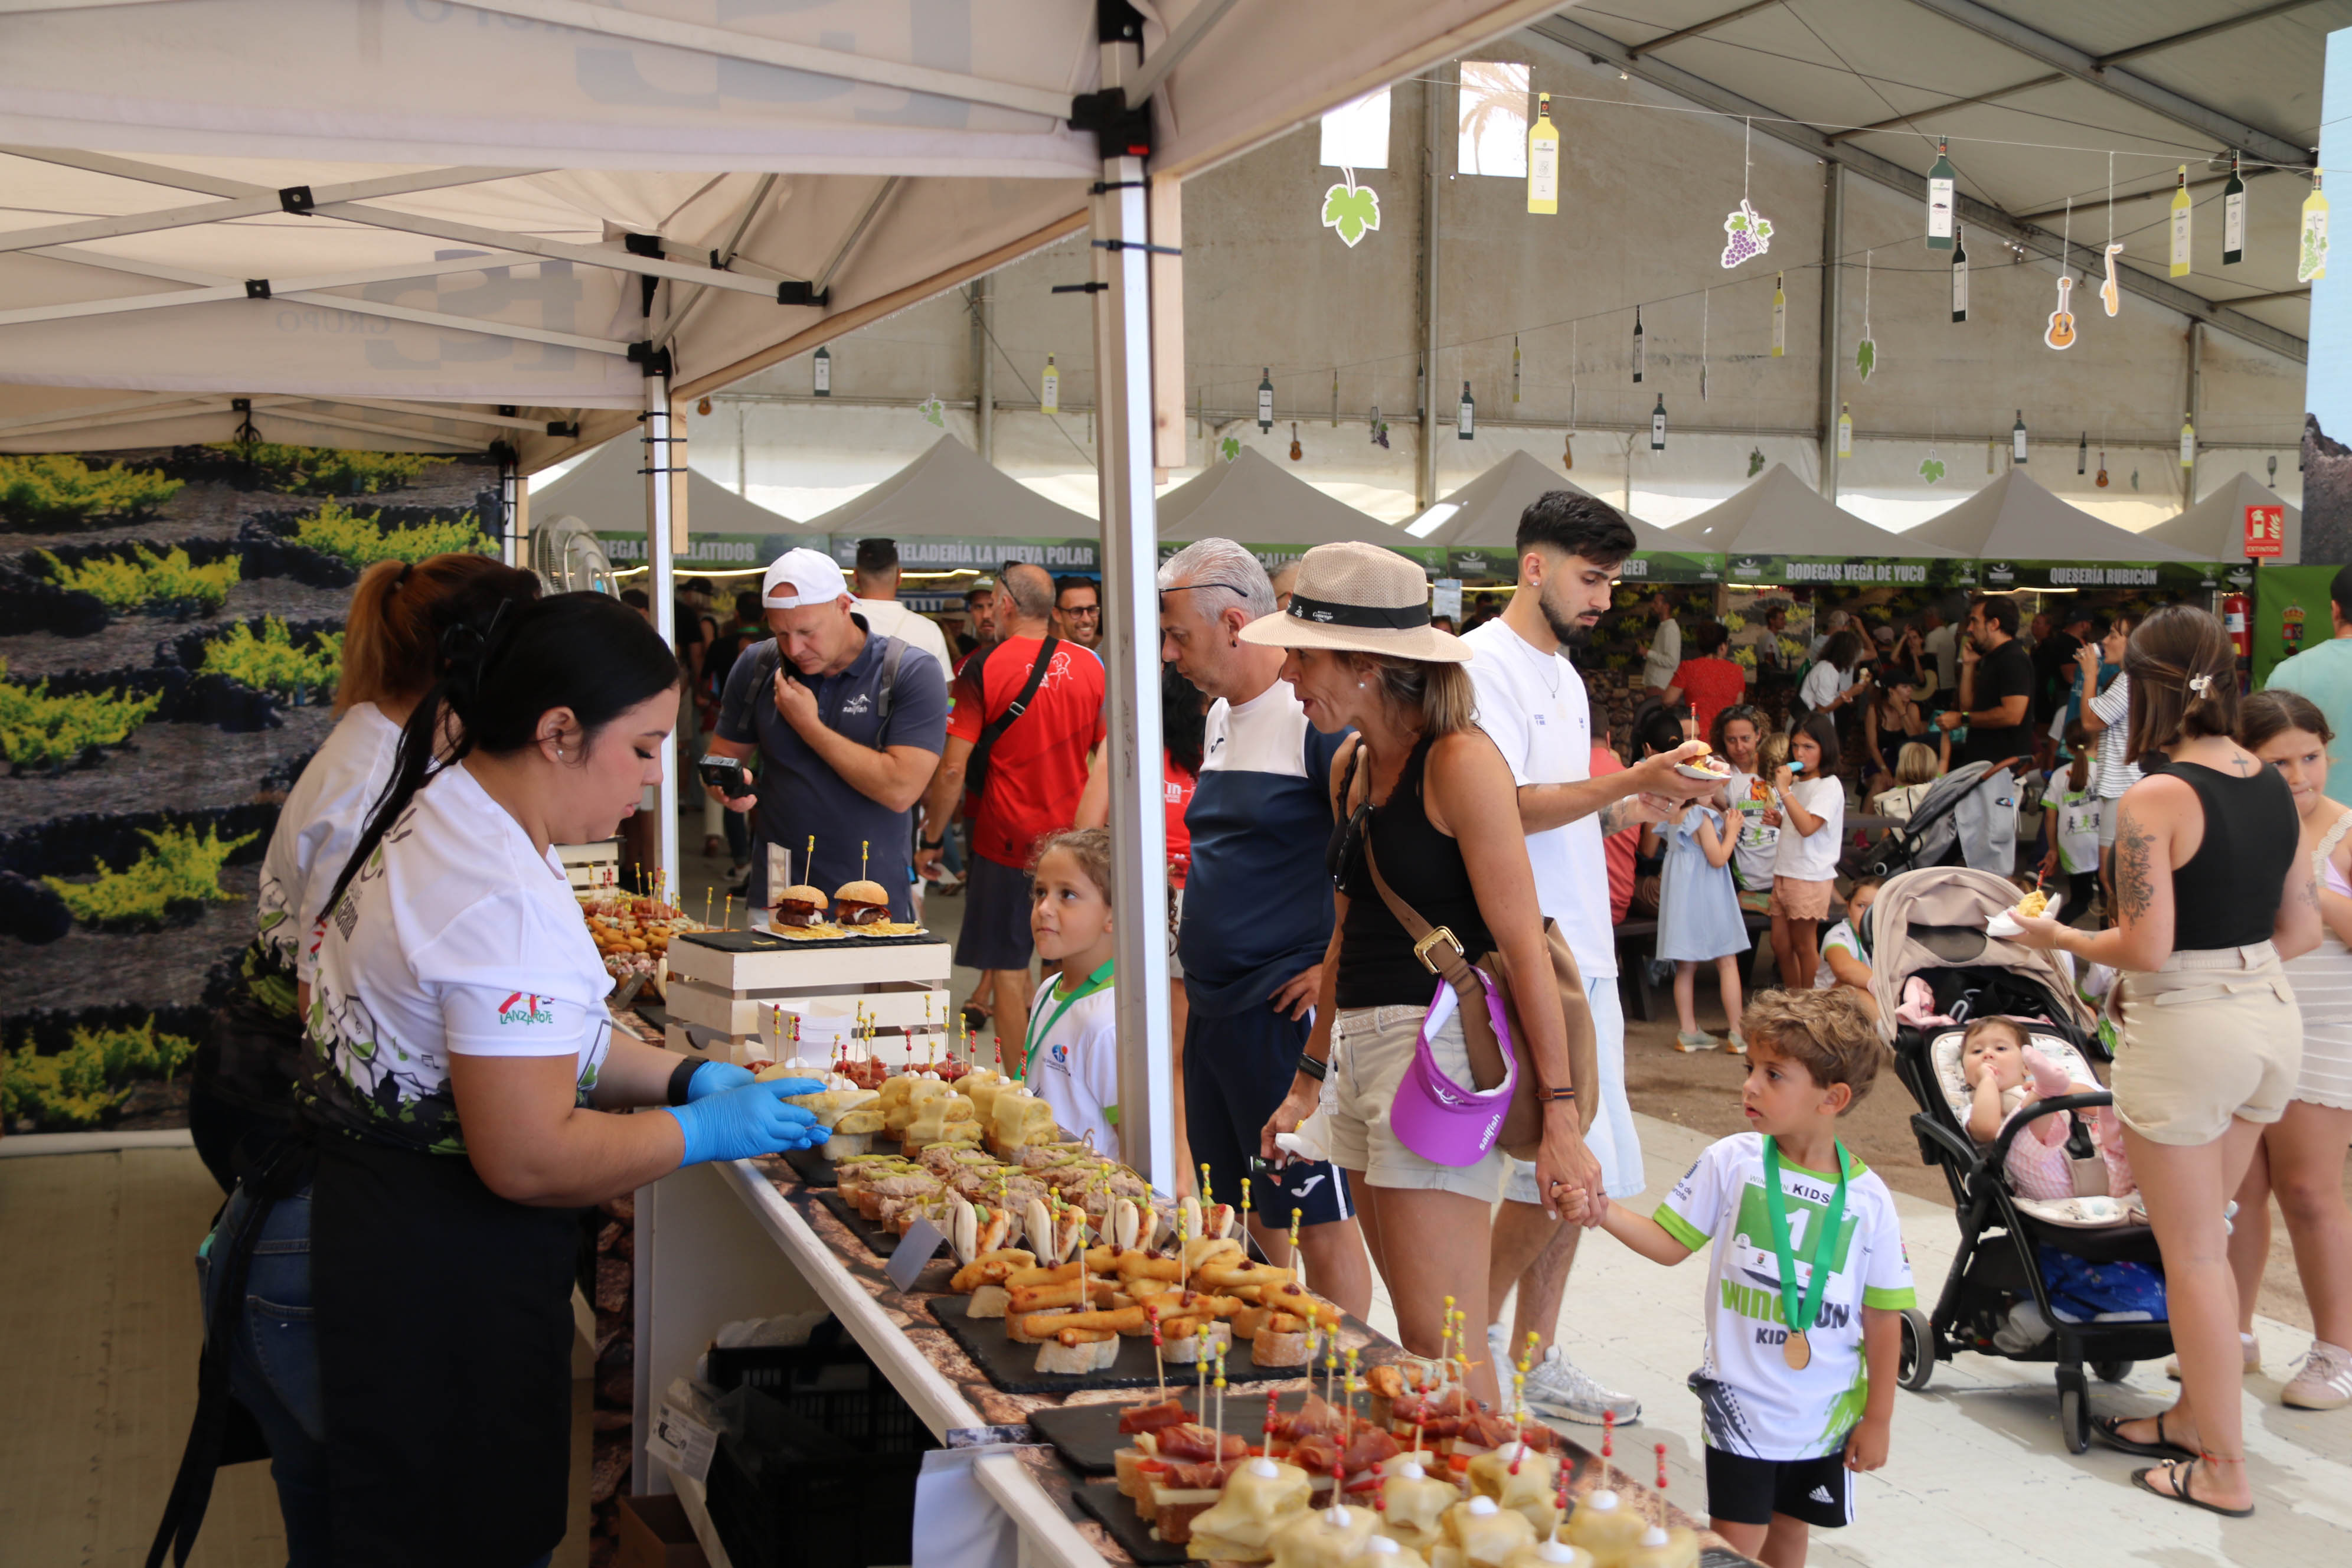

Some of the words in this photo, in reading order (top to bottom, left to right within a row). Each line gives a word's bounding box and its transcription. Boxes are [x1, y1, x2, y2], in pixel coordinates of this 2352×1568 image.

[673, 540, 756, 561] ELATIDOS
[975, 545, 992, 563] LA
[997, 545, 1043, 564] NUEVA
[1047, 547, 1093, 565] POLAR
[1786, 563, 1841, 580] BODEGAS
[1844, 564, 1874, 581] VEGA
[1877, 565, 1892, 581] DE
[1894, 565, 1925, 582] YUCO
[2050, 564, 2104, 584] QUESERÍA
[2106, 566, 2157, 585] RUBICÓN
[500, 1010, 553, 1025] LANZAROTE
[1479, 1113, 1501, 1151] sailfish
[1792, 1183, 1830, 1204] KIDS
[1785, 1207, 1811, 1252] 1
[1755, 1328, 1788, 1345] KID
